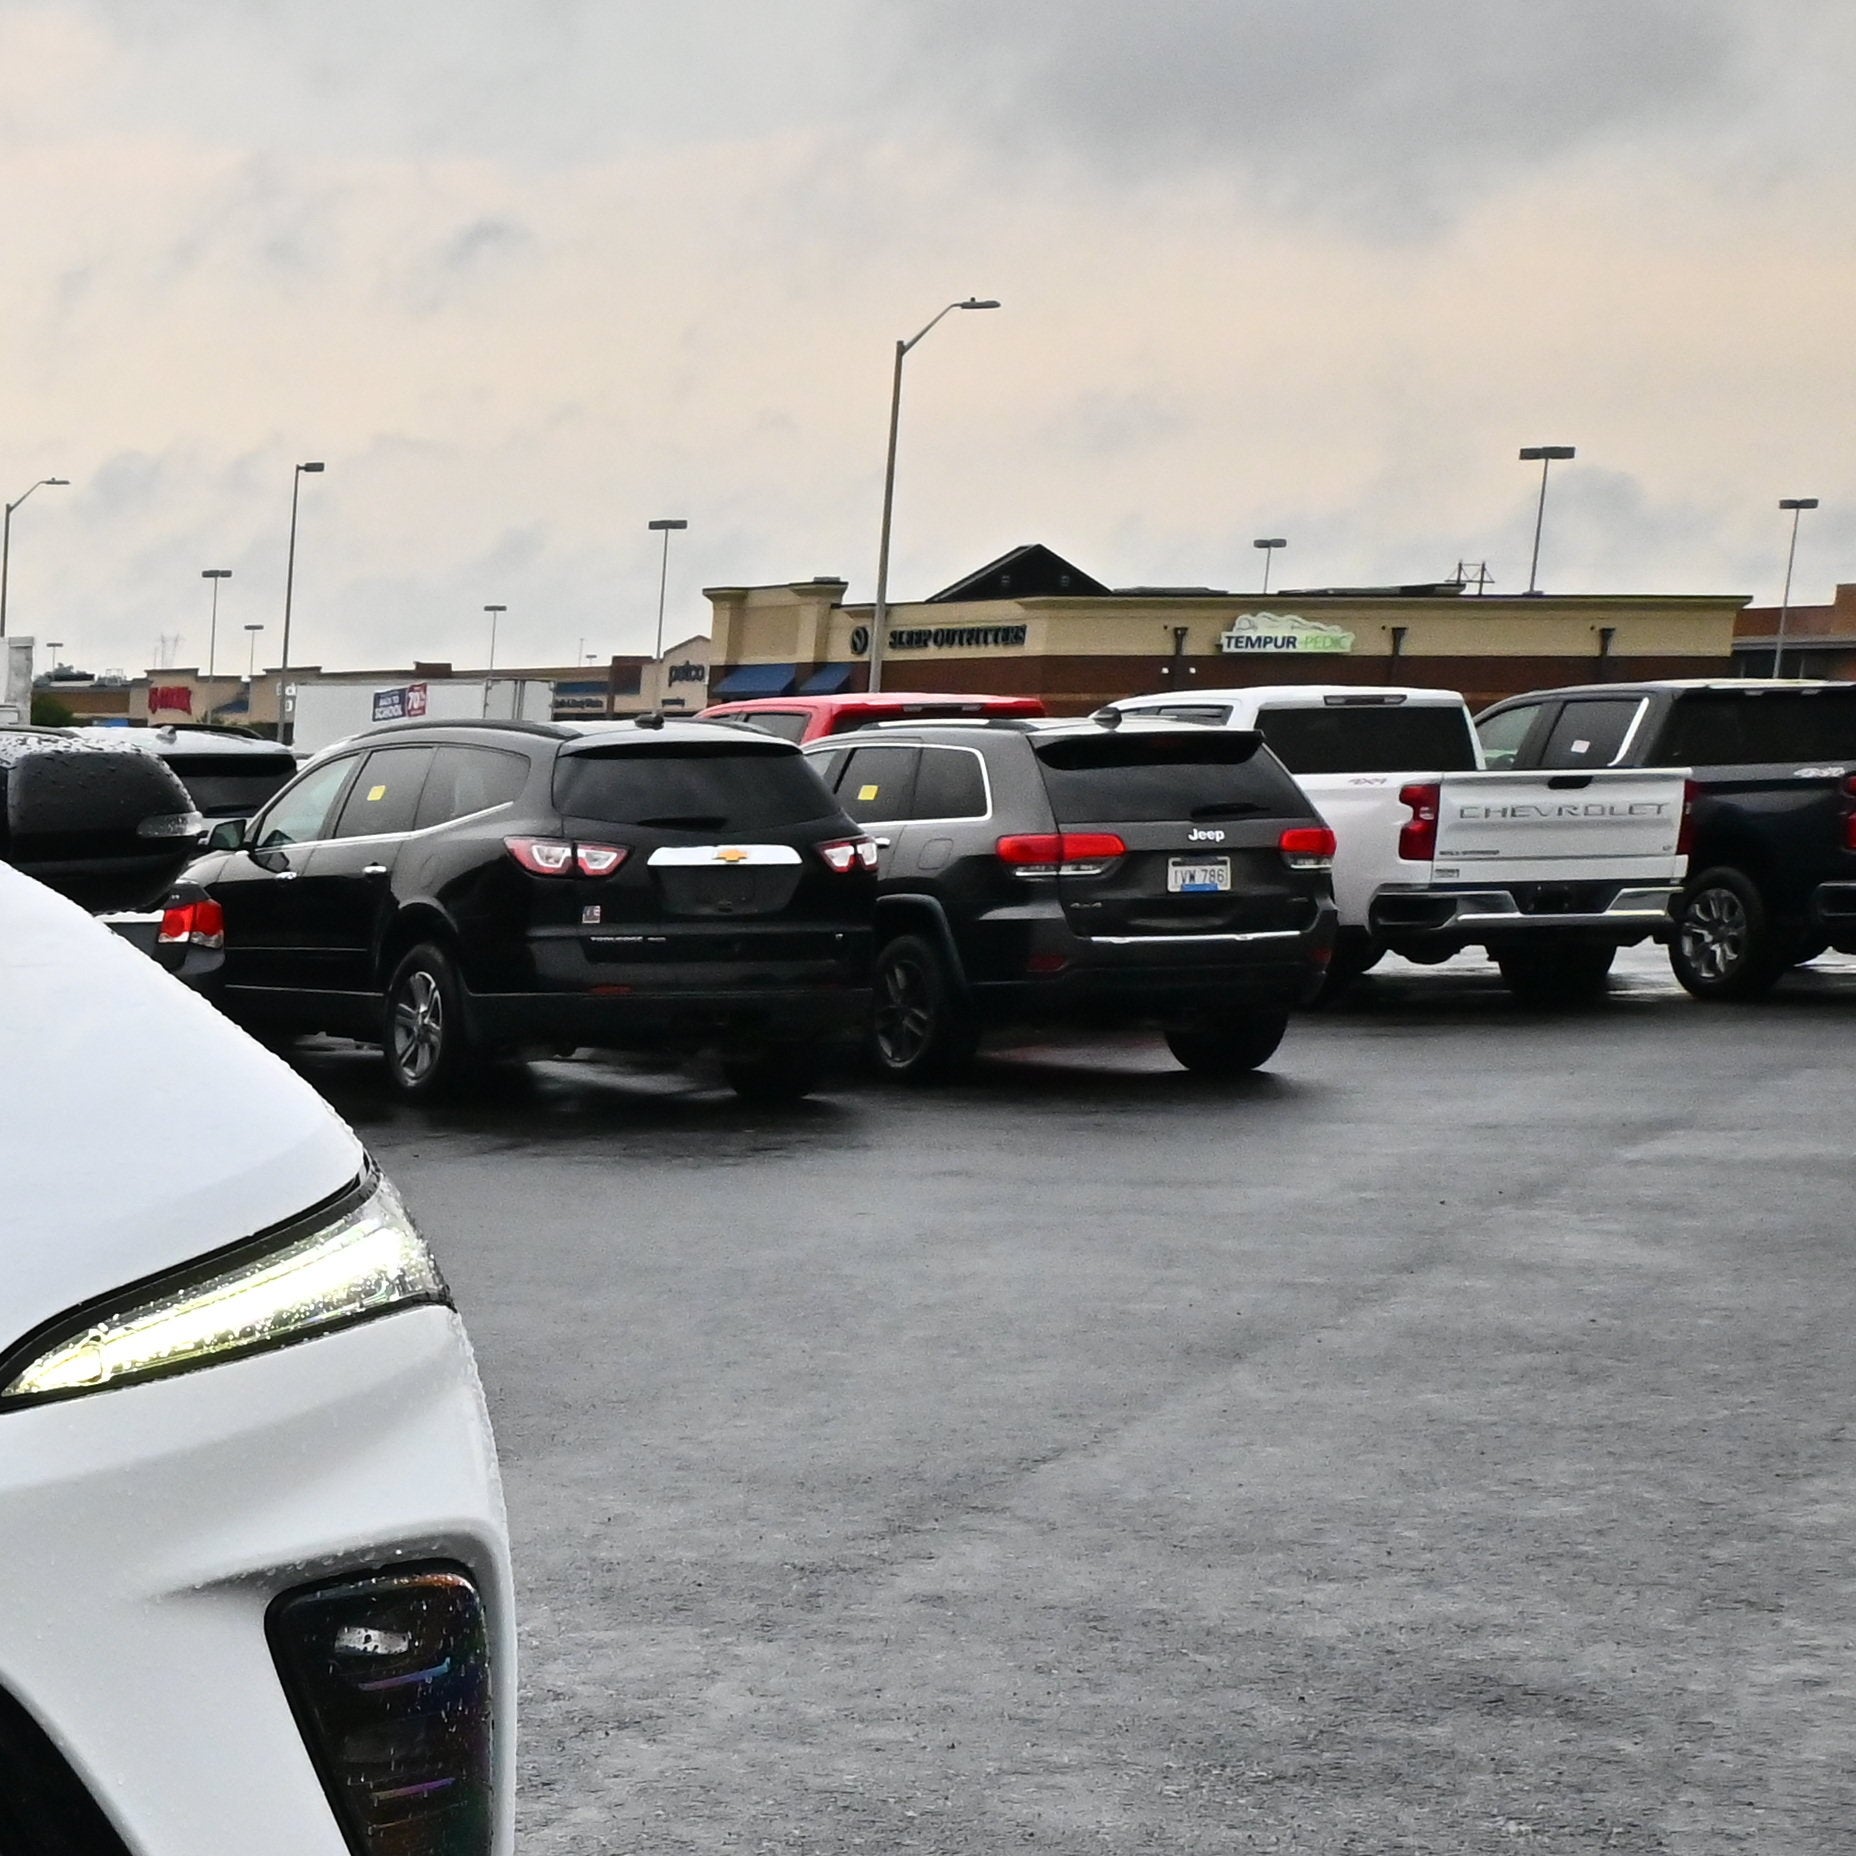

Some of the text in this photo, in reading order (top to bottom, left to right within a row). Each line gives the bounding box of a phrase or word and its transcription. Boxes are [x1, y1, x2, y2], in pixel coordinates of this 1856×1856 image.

[933, 625, 1027, 648] OUTFITTERS
[1459, 803, 1670, 819] CHEVROLET
[1188, 828, 1225, 842] Jeep
[1201, 868, 1225, 884] 786
